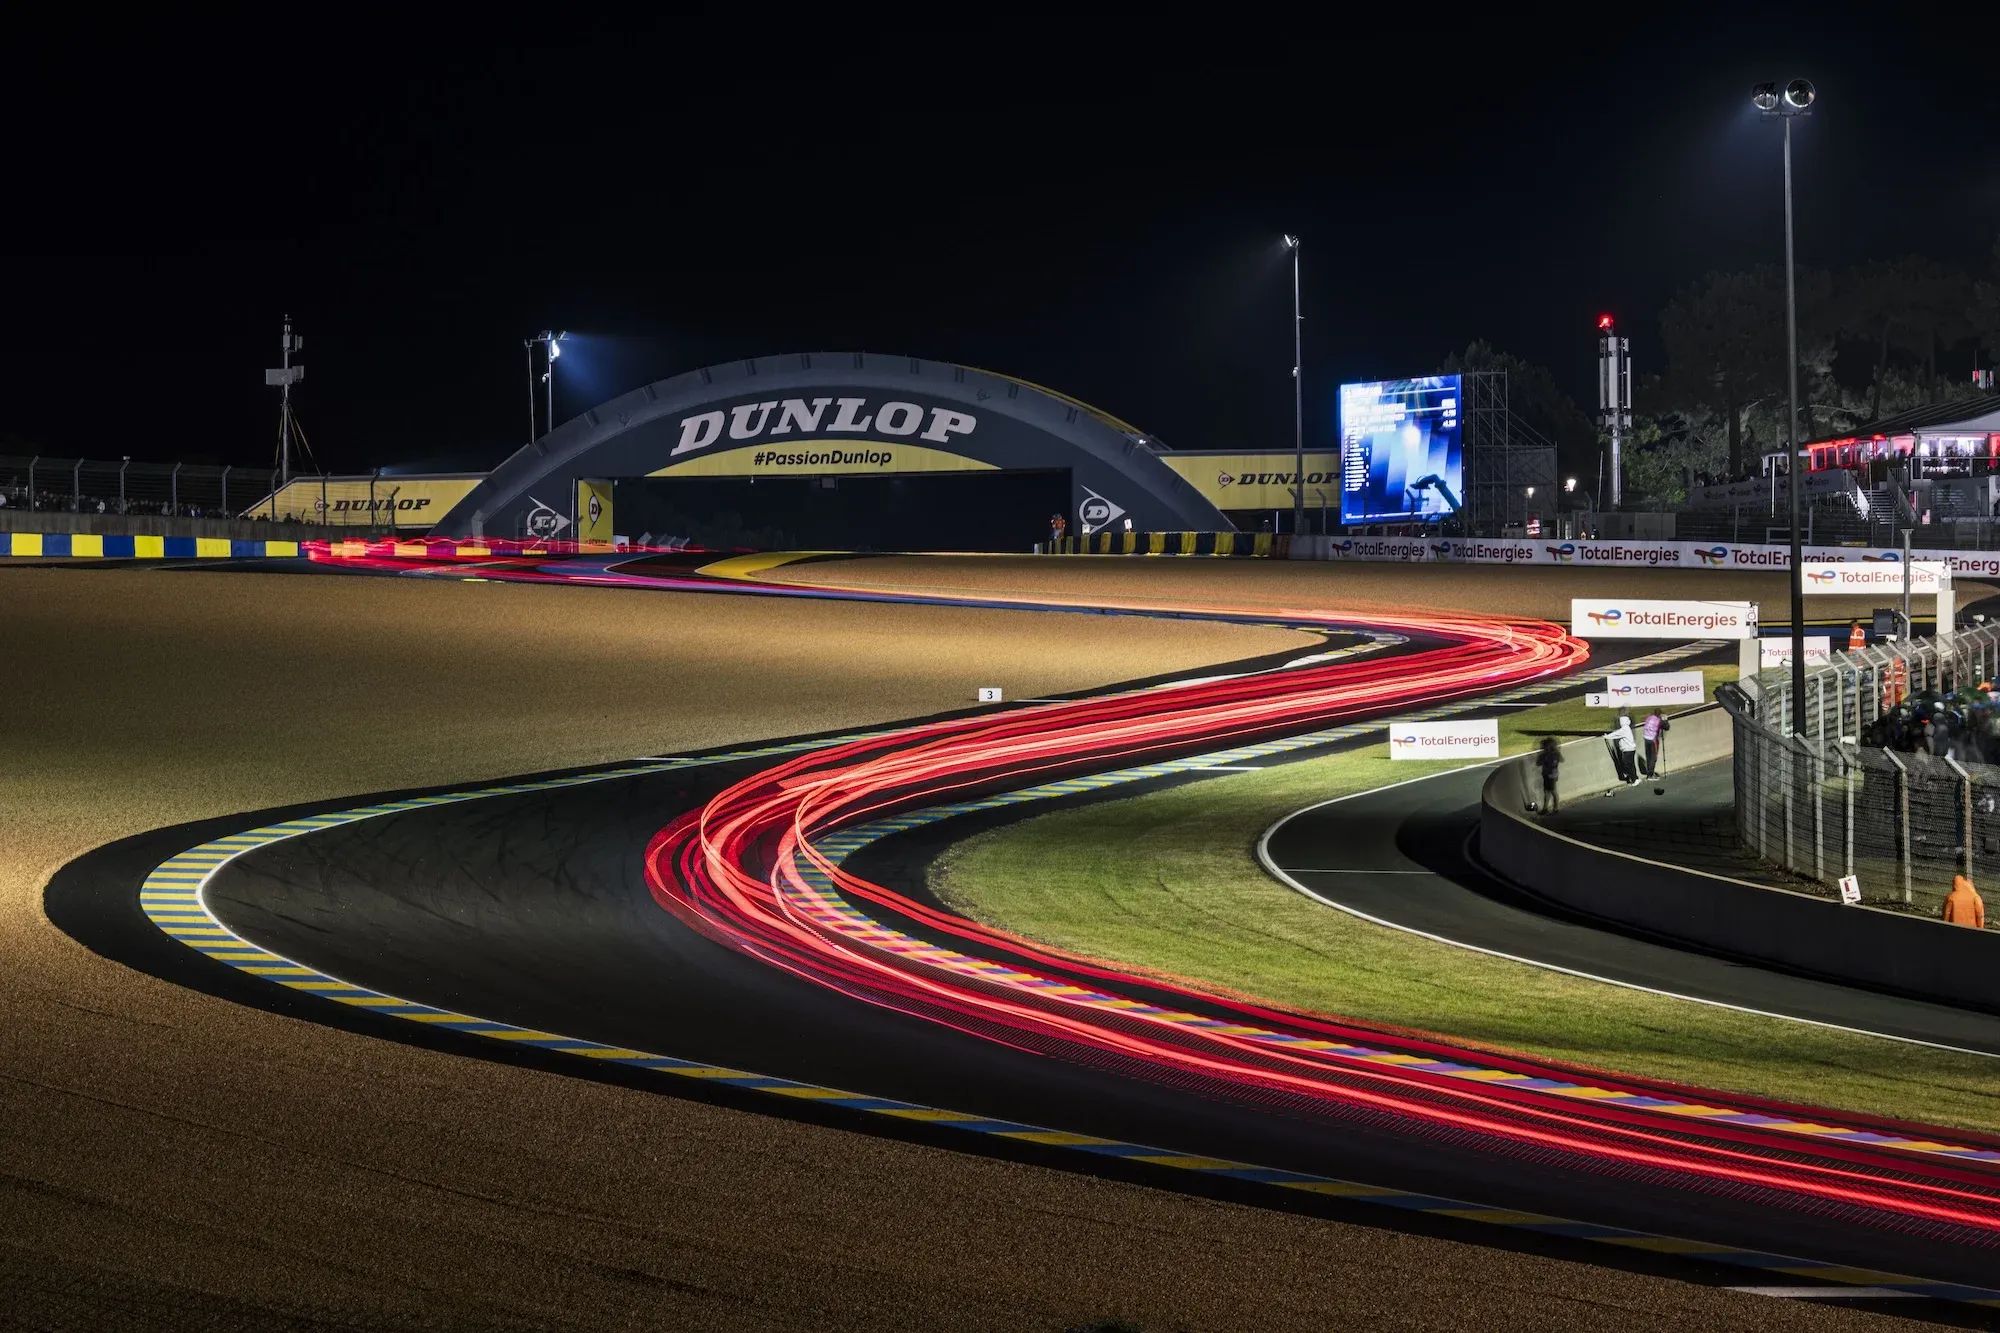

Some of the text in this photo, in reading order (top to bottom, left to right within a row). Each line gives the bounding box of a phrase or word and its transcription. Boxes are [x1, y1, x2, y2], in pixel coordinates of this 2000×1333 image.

[670, 397, 977, 456] DUNLOP
[754, 450, 892, 467] #PassionDunlop
[1238, 472, 1340, 485] DUNLOP
[333, 499, 431, 511] DUNLOP
[1353, 543, 1425, 558] TotalEnergies
[1453, 544, 1533, 561] TotalEnergies
[1578, 546, 1680, 564] TotalEnergies
[1625, 611, 1737, 628] TotalEnergies
[1767, 647, 1826, 657] TotalErgies
[987, 690, 993, 699] 3
[1633, 683, 1700, 695] TotalEnergies
[1594, 696, 1600, 704] 3
[1419, 734, 1496, 746] TotalEnergies
